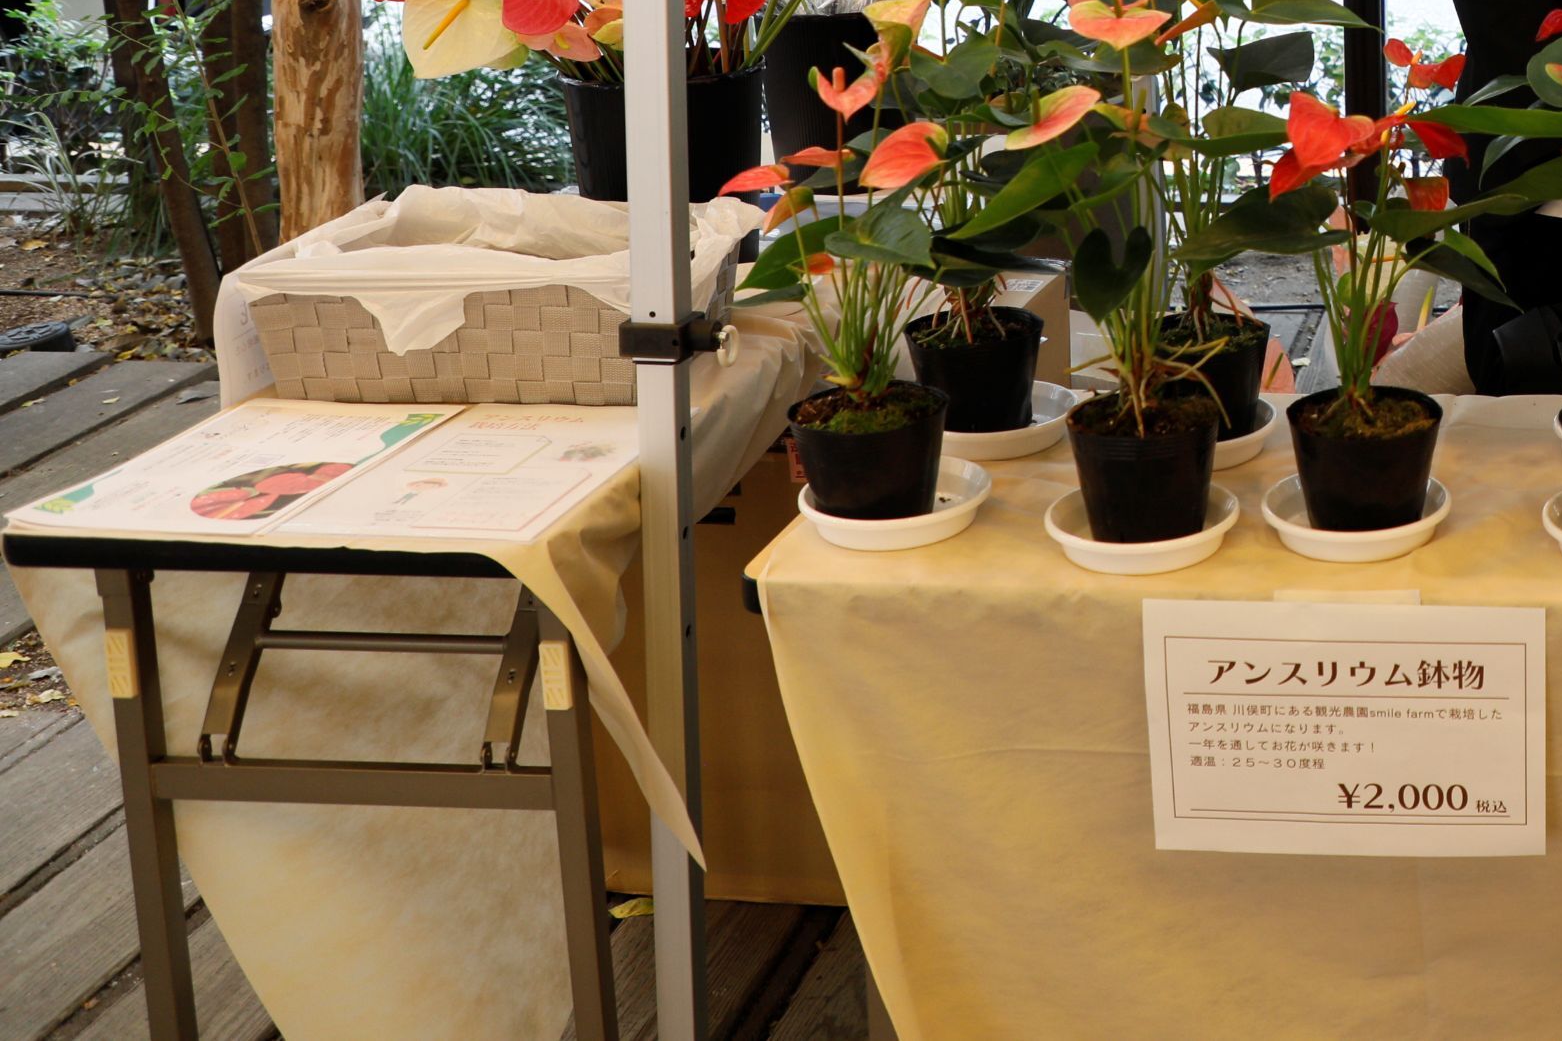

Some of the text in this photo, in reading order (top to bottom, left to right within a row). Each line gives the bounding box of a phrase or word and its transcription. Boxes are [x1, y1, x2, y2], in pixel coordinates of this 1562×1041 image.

[1209, 659, 1485, 690] アンスリウム鉢物
[1187, 703, 1227, 716] 福島県
[1406, 707, 1502, 721] farmで栽培した
[1188, 721, 1344, 735] アンスリウムになります。
[1337, 783, 1507, 814] ¥2,000 税込
